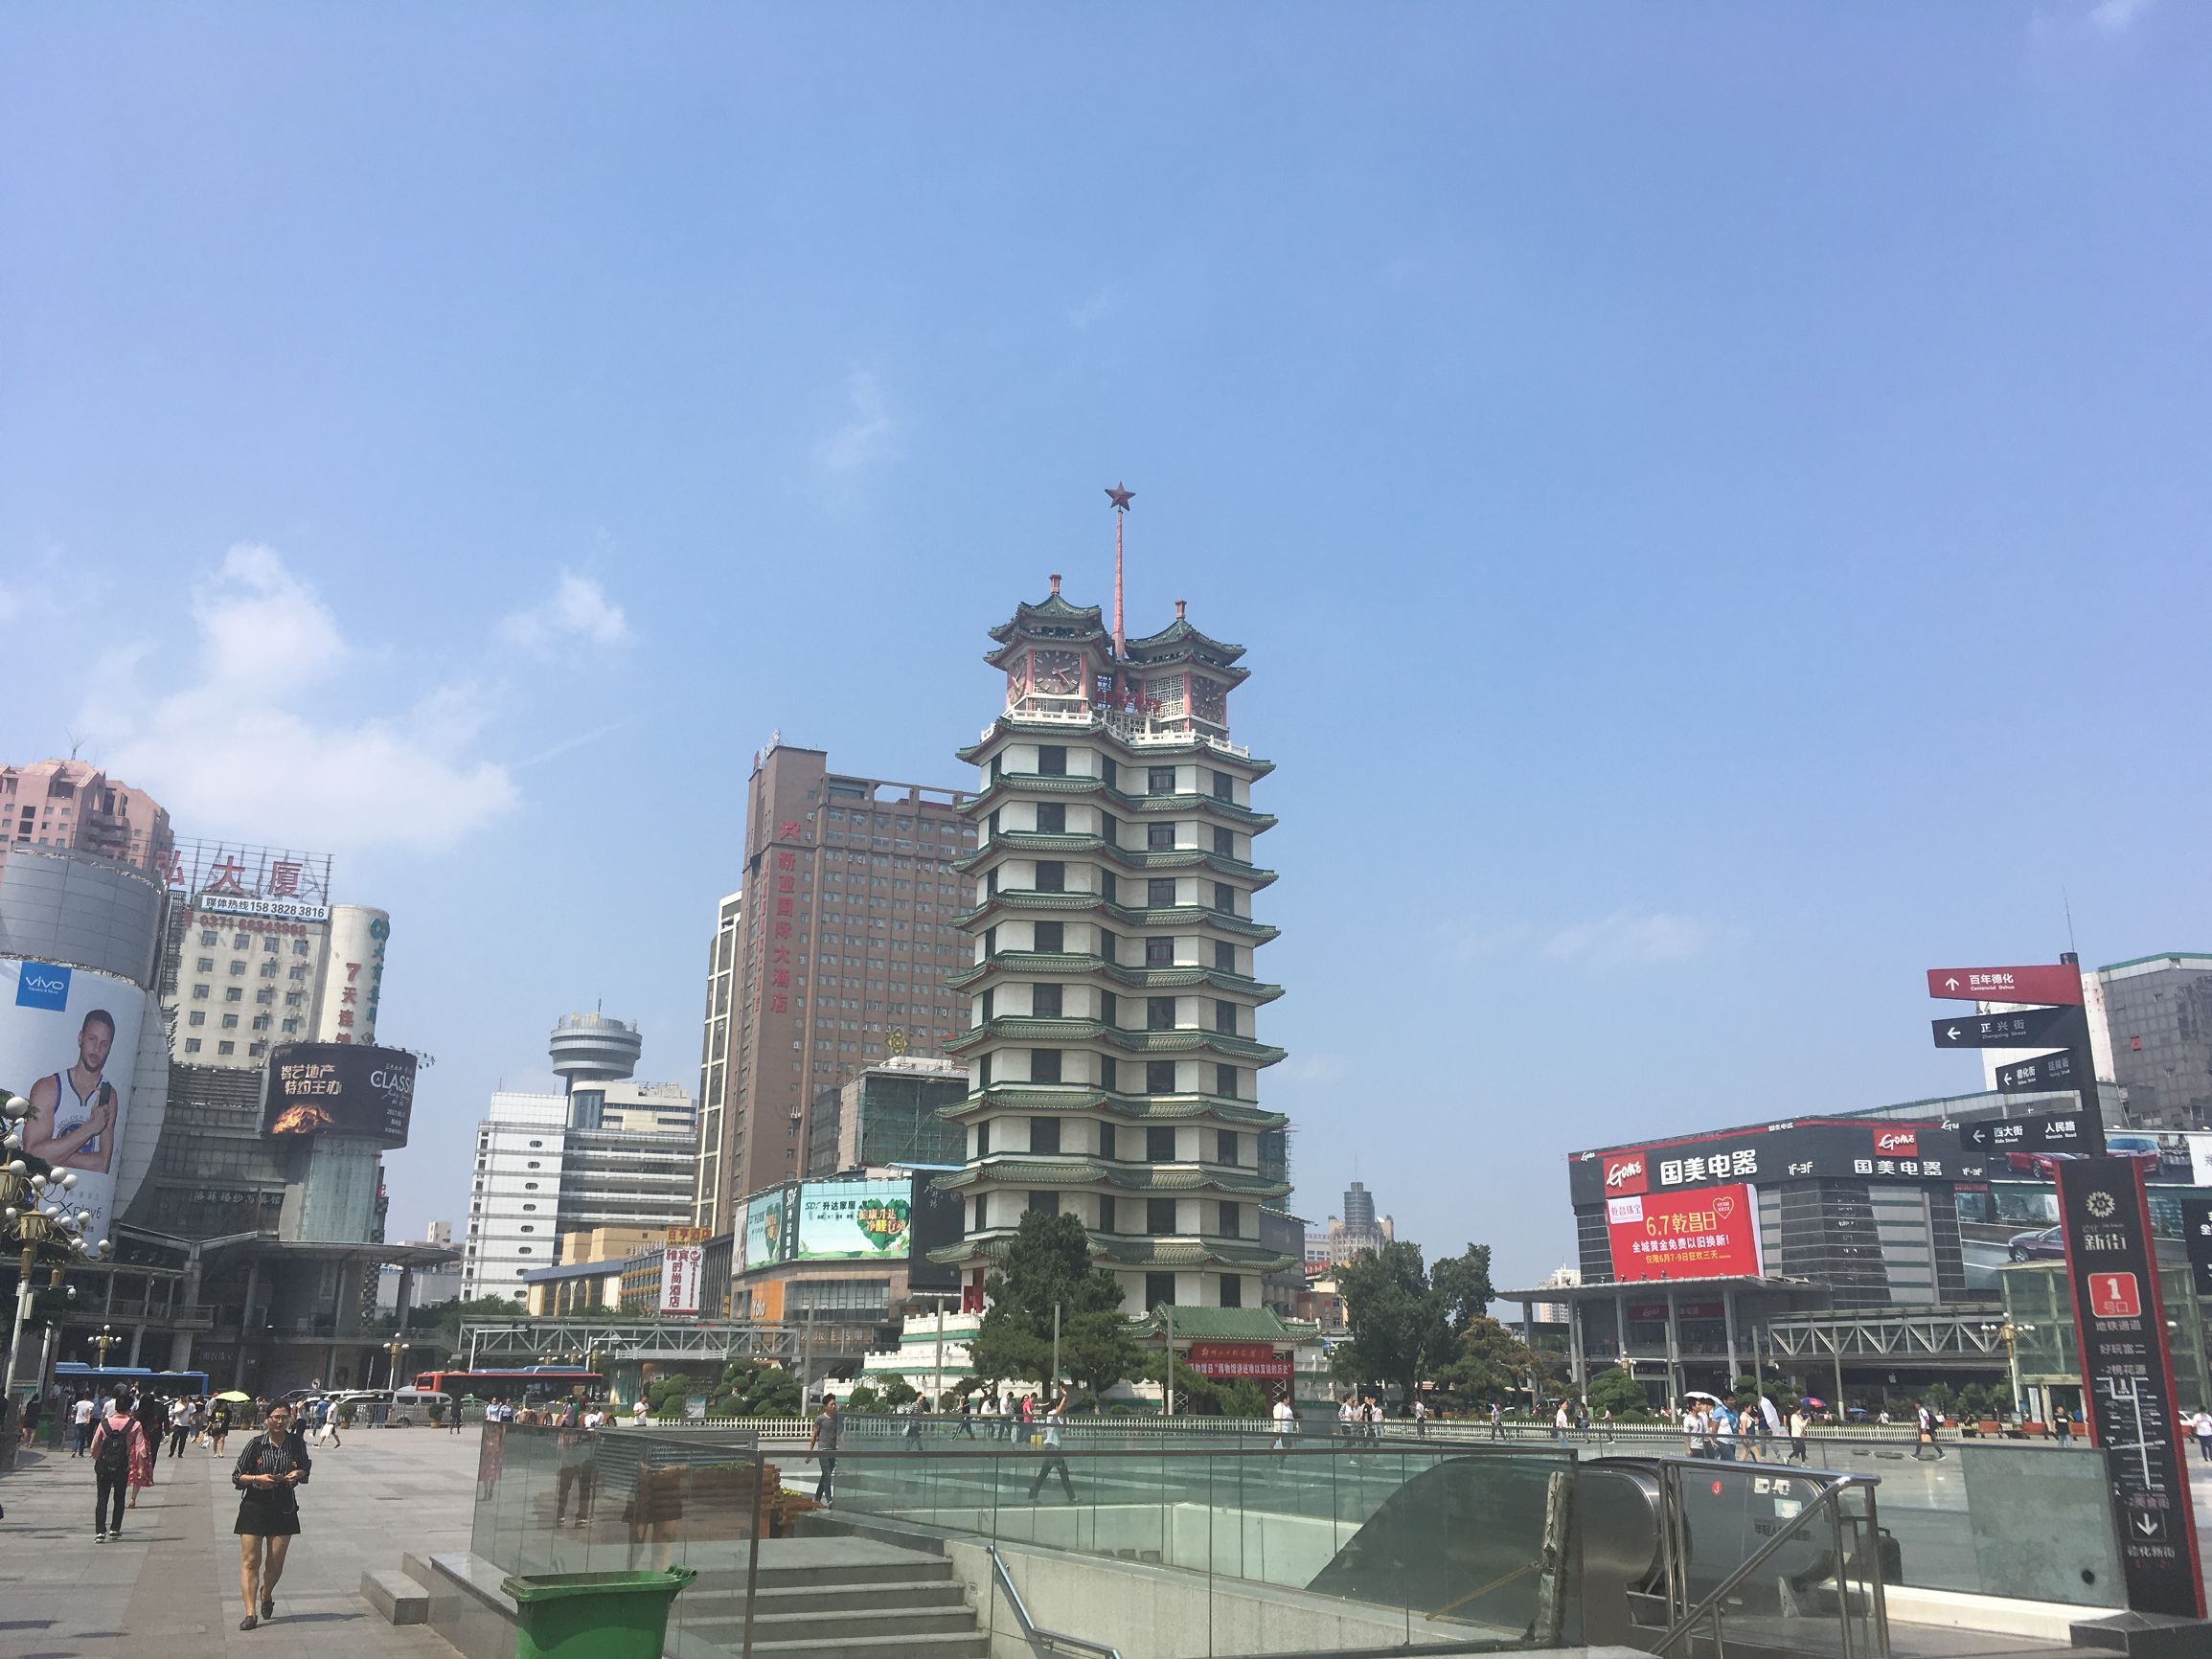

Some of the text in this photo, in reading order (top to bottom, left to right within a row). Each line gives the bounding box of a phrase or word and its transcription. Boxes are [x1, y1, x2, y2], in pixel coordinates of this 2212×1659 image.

[271, 903, 296, 916] 3828
[299, 906, 325, 918] 3816
[26, 976, 64, 990] vivo
[1970, 973, 2014, 985] 百年德化
[1980, 1019, 2024, 1033] 正兴街
[281, 1064, 335, 1080] 锦艺地产
[2017, 1066, 2036, 1079] 德化街
[285, 1080, 342, 1095] 特约主办
[1994, 1125, 2023, 1137] 西大街
[2045, 1121, 2076, 1133] 人民路
[1660, 1149, 1758, 1186] 国美电器
[1788, 1162, 1813, 1176] 1F-3F
[1854, 1159, 1943, 1175] 国美电器
[1962, 1168, 1983, 1176] 1F-3F
[823, 1201, 855, 1211] 升达家居
[2107, 1278, 2122, 1300] 1
